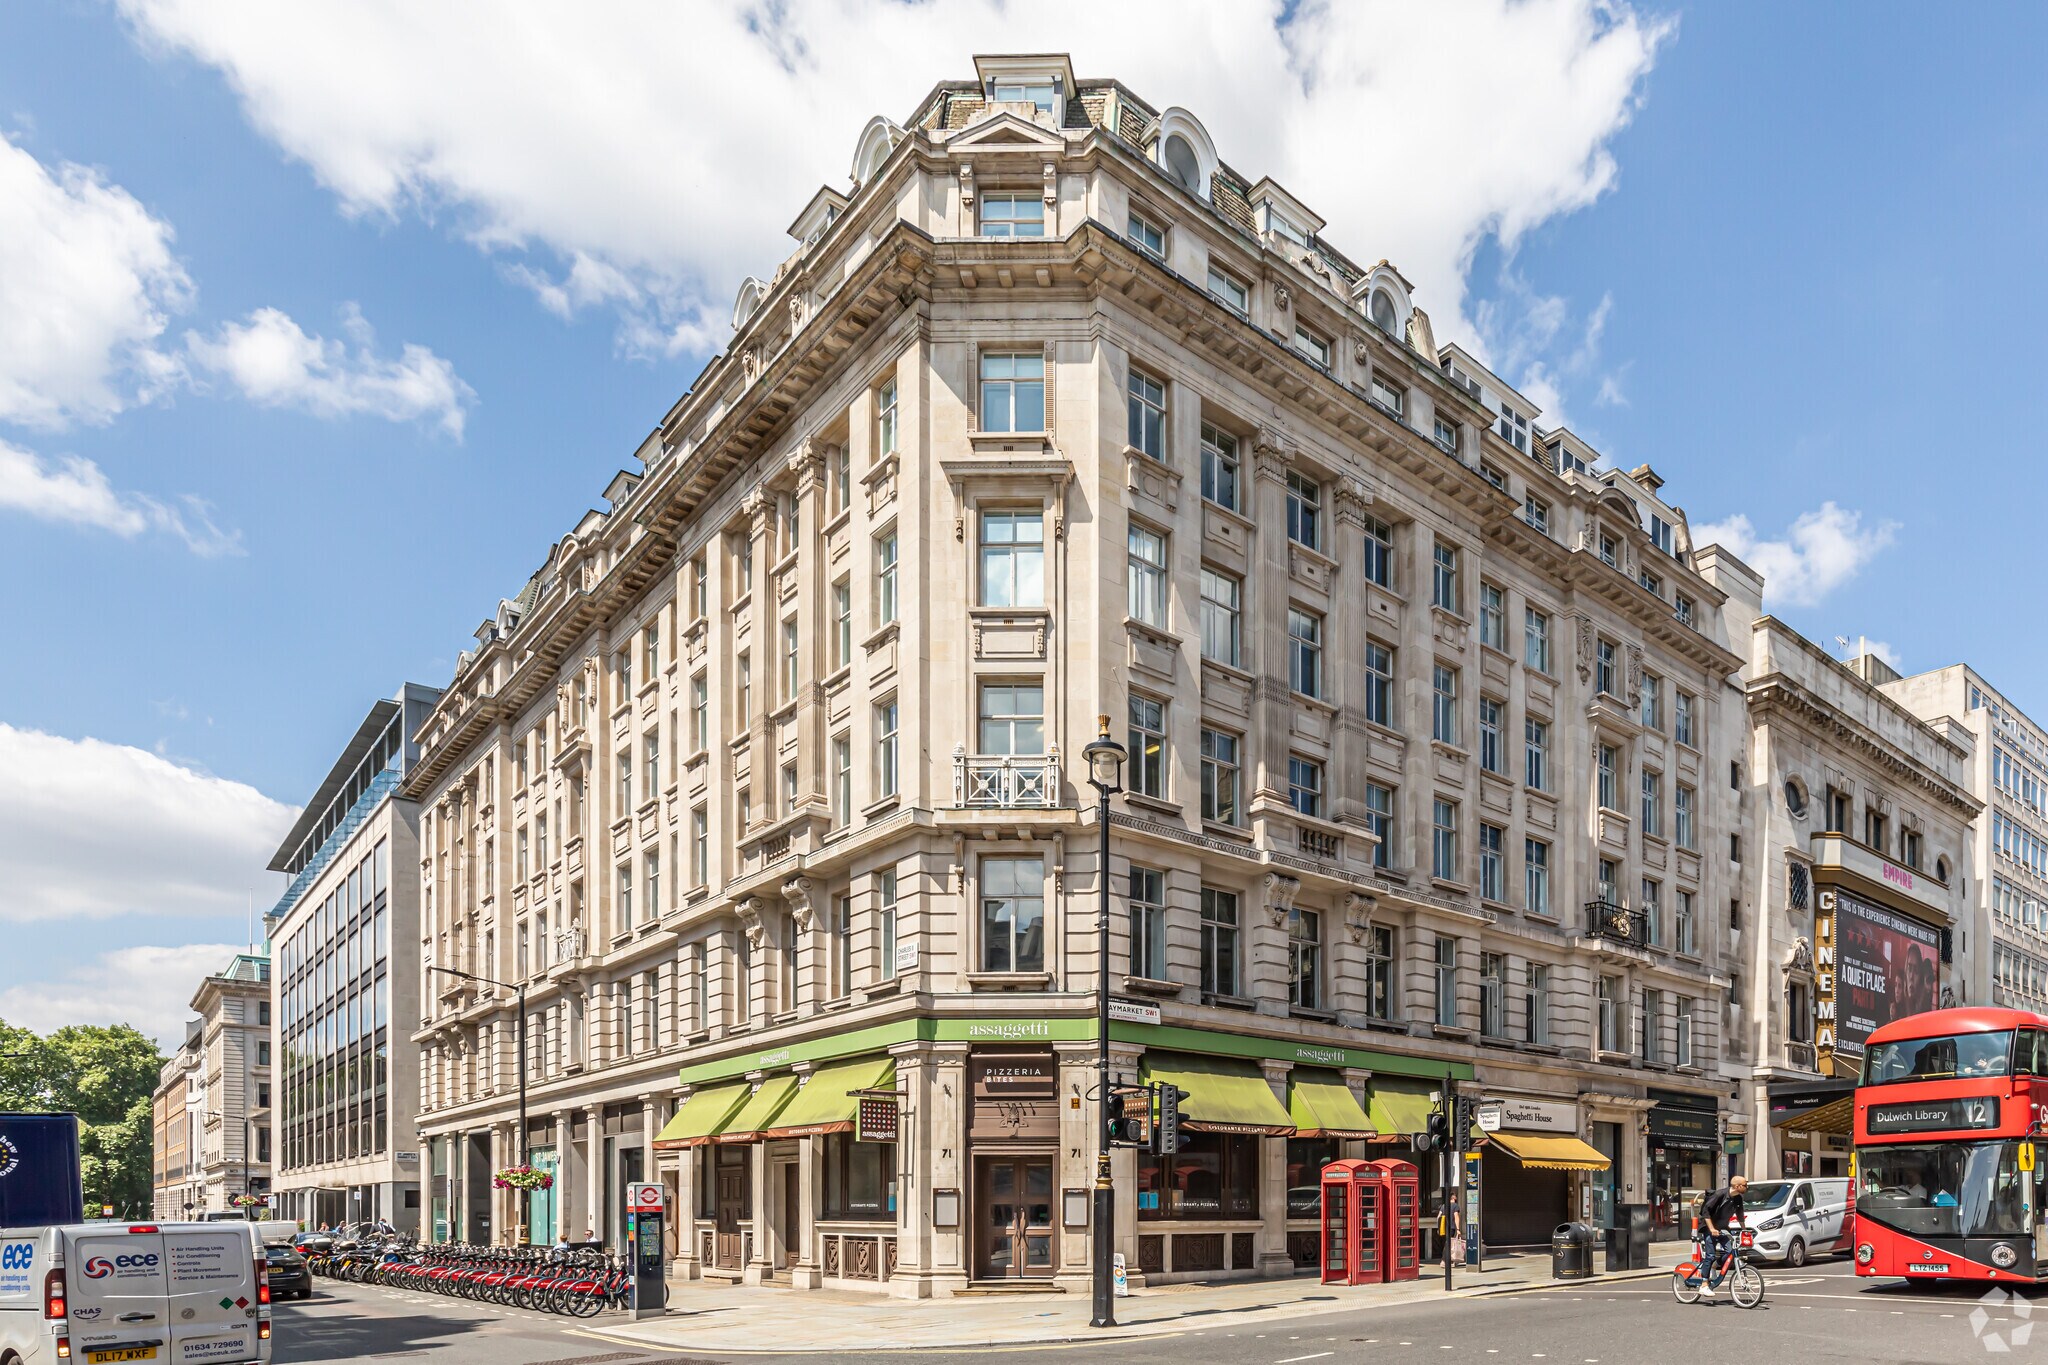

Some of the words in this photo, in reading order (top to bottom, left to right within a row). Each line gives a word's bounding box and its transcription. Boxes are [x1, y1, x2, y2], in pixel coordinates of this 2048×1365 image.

[1883, 862, 1913, 890] EMPIRE
[1852, 903, 1857, 914] IS
[1858, 905, 1866, 917] THE
[1866, 909, 1891, 926] EXPERIENCE
[1891, 918, 1908, 933] CINEMAS
[1908, 925, 1918, 938] WERE
[1817, 892, 1835, 1046] CINEMA
[1841, 964, 1847, 982] A
[1847, 966, 1866, 988] QUIET
[1866, 971, 1886, 993] PLACE
[1109, 1005, 1143, 1015] AYMARKET
[1145, 1009, 1158, 1017] SW1
[969, 1020, 1049, 1039] assaggetti
[760, 1048, 790, 1065] assaggetti
[1296, 1048, 1345, 1063] assaggetti
[986, 1068, 1041, 1076] PIZZERIA
[1506, 1110, 1533, 1123] Spaghetti
[1534, 1113, 1553, 1122] House
[1877, 1110, 1913, 1122] Dulwich
[1915, 1110, 1948, 1122] Library
[1968, 1103, 1987, 1123] 12
[862, 1130, 896, 1139] assaggetti
[1788, 1130, 1808, 1139] Haymarket
[942, 1149, 952, 1158] 71
[1071, 1149, 1081, 1158] 71
[3, 1243, 33, 1270] ece
[115, 1253, 159, 1268] ece
[73, 1307, 102, 1316] CHAS
[184, 1343, 210, 1352] 01634
[212, 1340, 244, 1349] 729690
[96, 1350, 122, 1363] DL17
[126, 1348, 149, 1359] WXF
[184, 1349, 245, 1359] sales@eceuk.com
